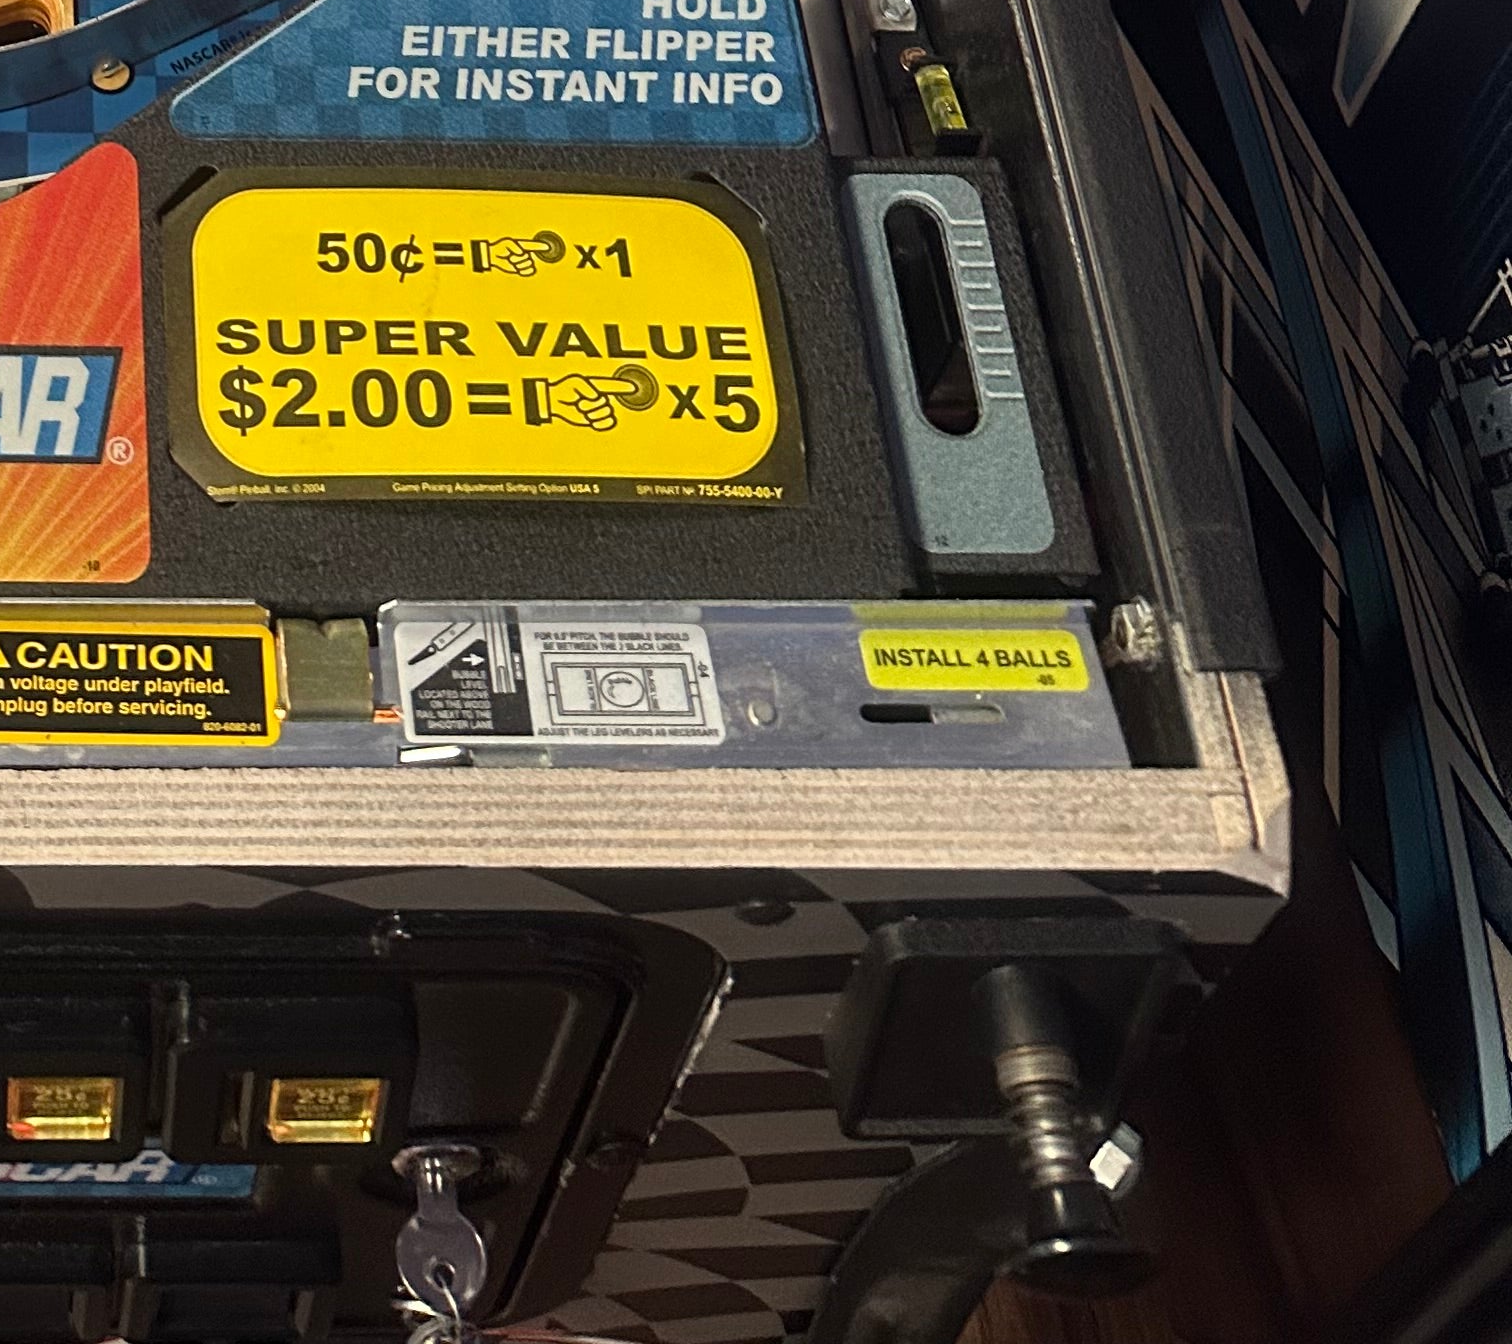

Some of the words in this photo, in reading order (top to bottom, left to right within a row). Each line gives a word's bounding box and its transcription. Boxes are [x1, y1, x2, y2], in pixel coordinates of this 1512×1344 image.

[400, 24, 570, 60] EITHER
[586, 29, 776, 64] FLIPPER
[347, 66, 445, 100] FOR
[455, 68, 658, 104] INSTANT
[672, 71, 784, 106] INFO
[216, 318, 476, 358] SUPER
[497, 321, 755, 362] VALUE
[16, 641, 214, 672] CAUTION
[873, 648, 972, 667] INSTALL
[975, 649, 989, 667] 4
[994, 649, 1072, 668] BALLS
[9, 674, 78, 695] voltage
[83, 677, 140, 695] under
[144, 677, 231, 696] playfield.
[52, 698, 114, 716] before
[117, 700, 212, 720] servicing.
